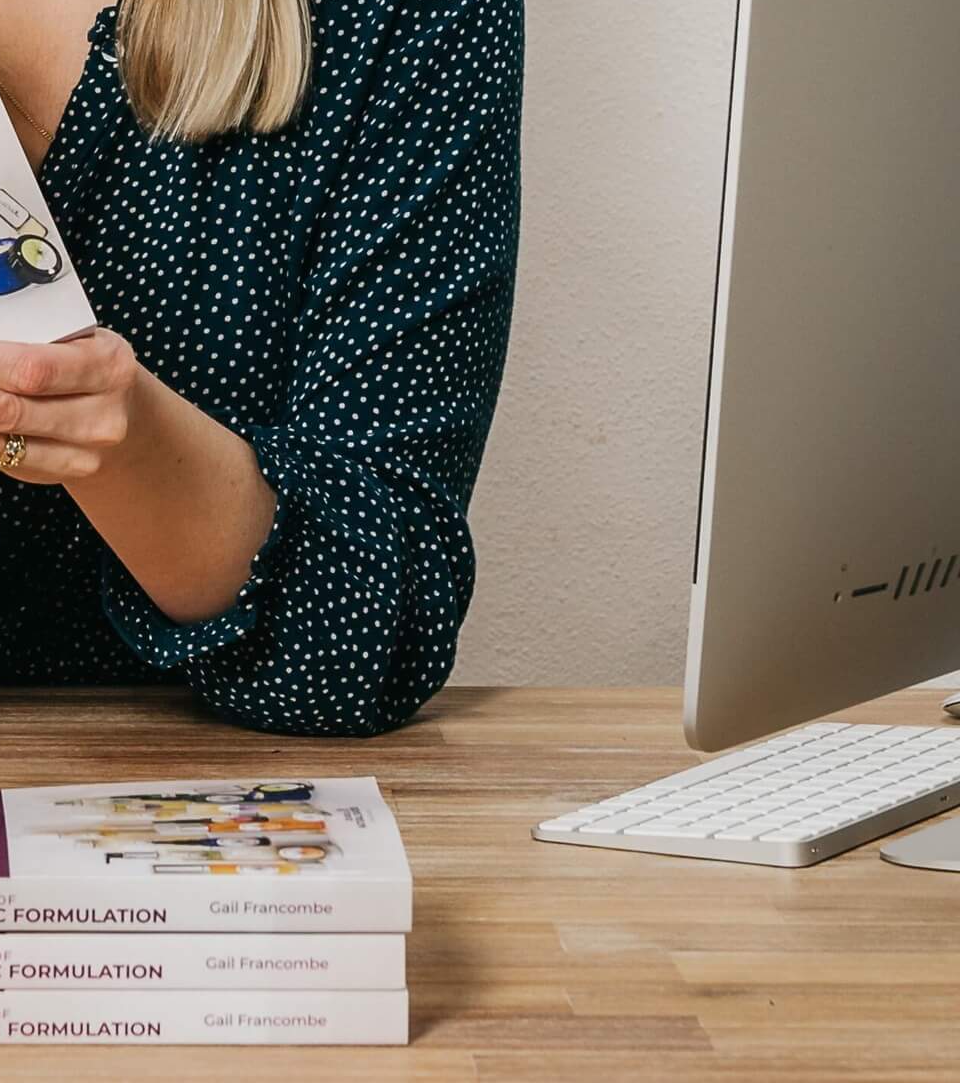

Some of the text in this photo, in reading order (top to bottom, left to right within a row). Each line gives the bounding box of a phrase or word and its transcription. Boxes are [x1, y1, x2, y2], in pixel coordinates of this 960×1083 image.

[209, 900, 333, 914] Gail Francombe
[14, 908, 167, 924] FORMULATION
[205, 957, 329, 970] Gail Francombe
[9, 964, 163, 979] FORMULATION
[203, 1013, 327, 1027] Gail Francombe
[8, 1022, 161, 1037] FORMULATION
